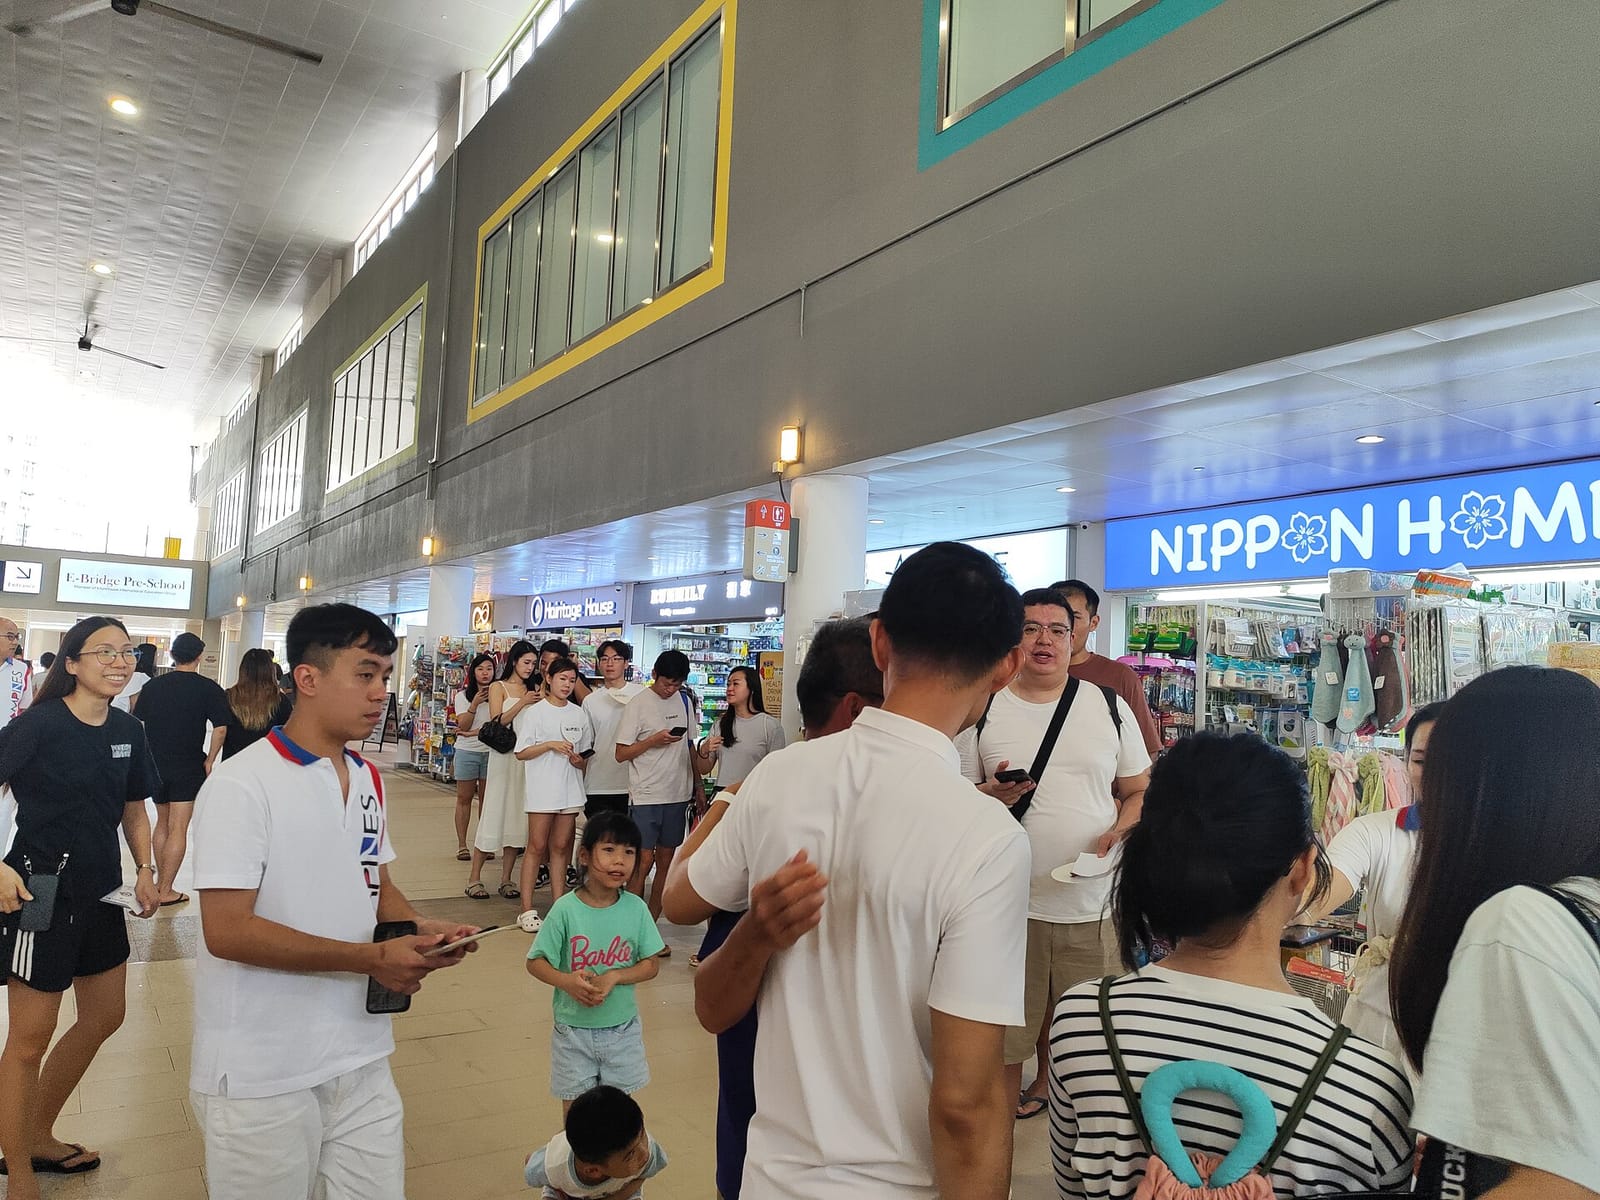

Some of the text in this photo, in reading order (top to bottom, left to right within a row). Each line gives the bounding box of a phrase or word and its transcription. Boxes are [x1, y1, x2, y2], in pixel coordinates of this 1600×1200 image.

[66, 572, 186, 590] E-Bridge Pre-School
[585, 598, 614, 616] House
[570, 935, 631, 971] Barbie
